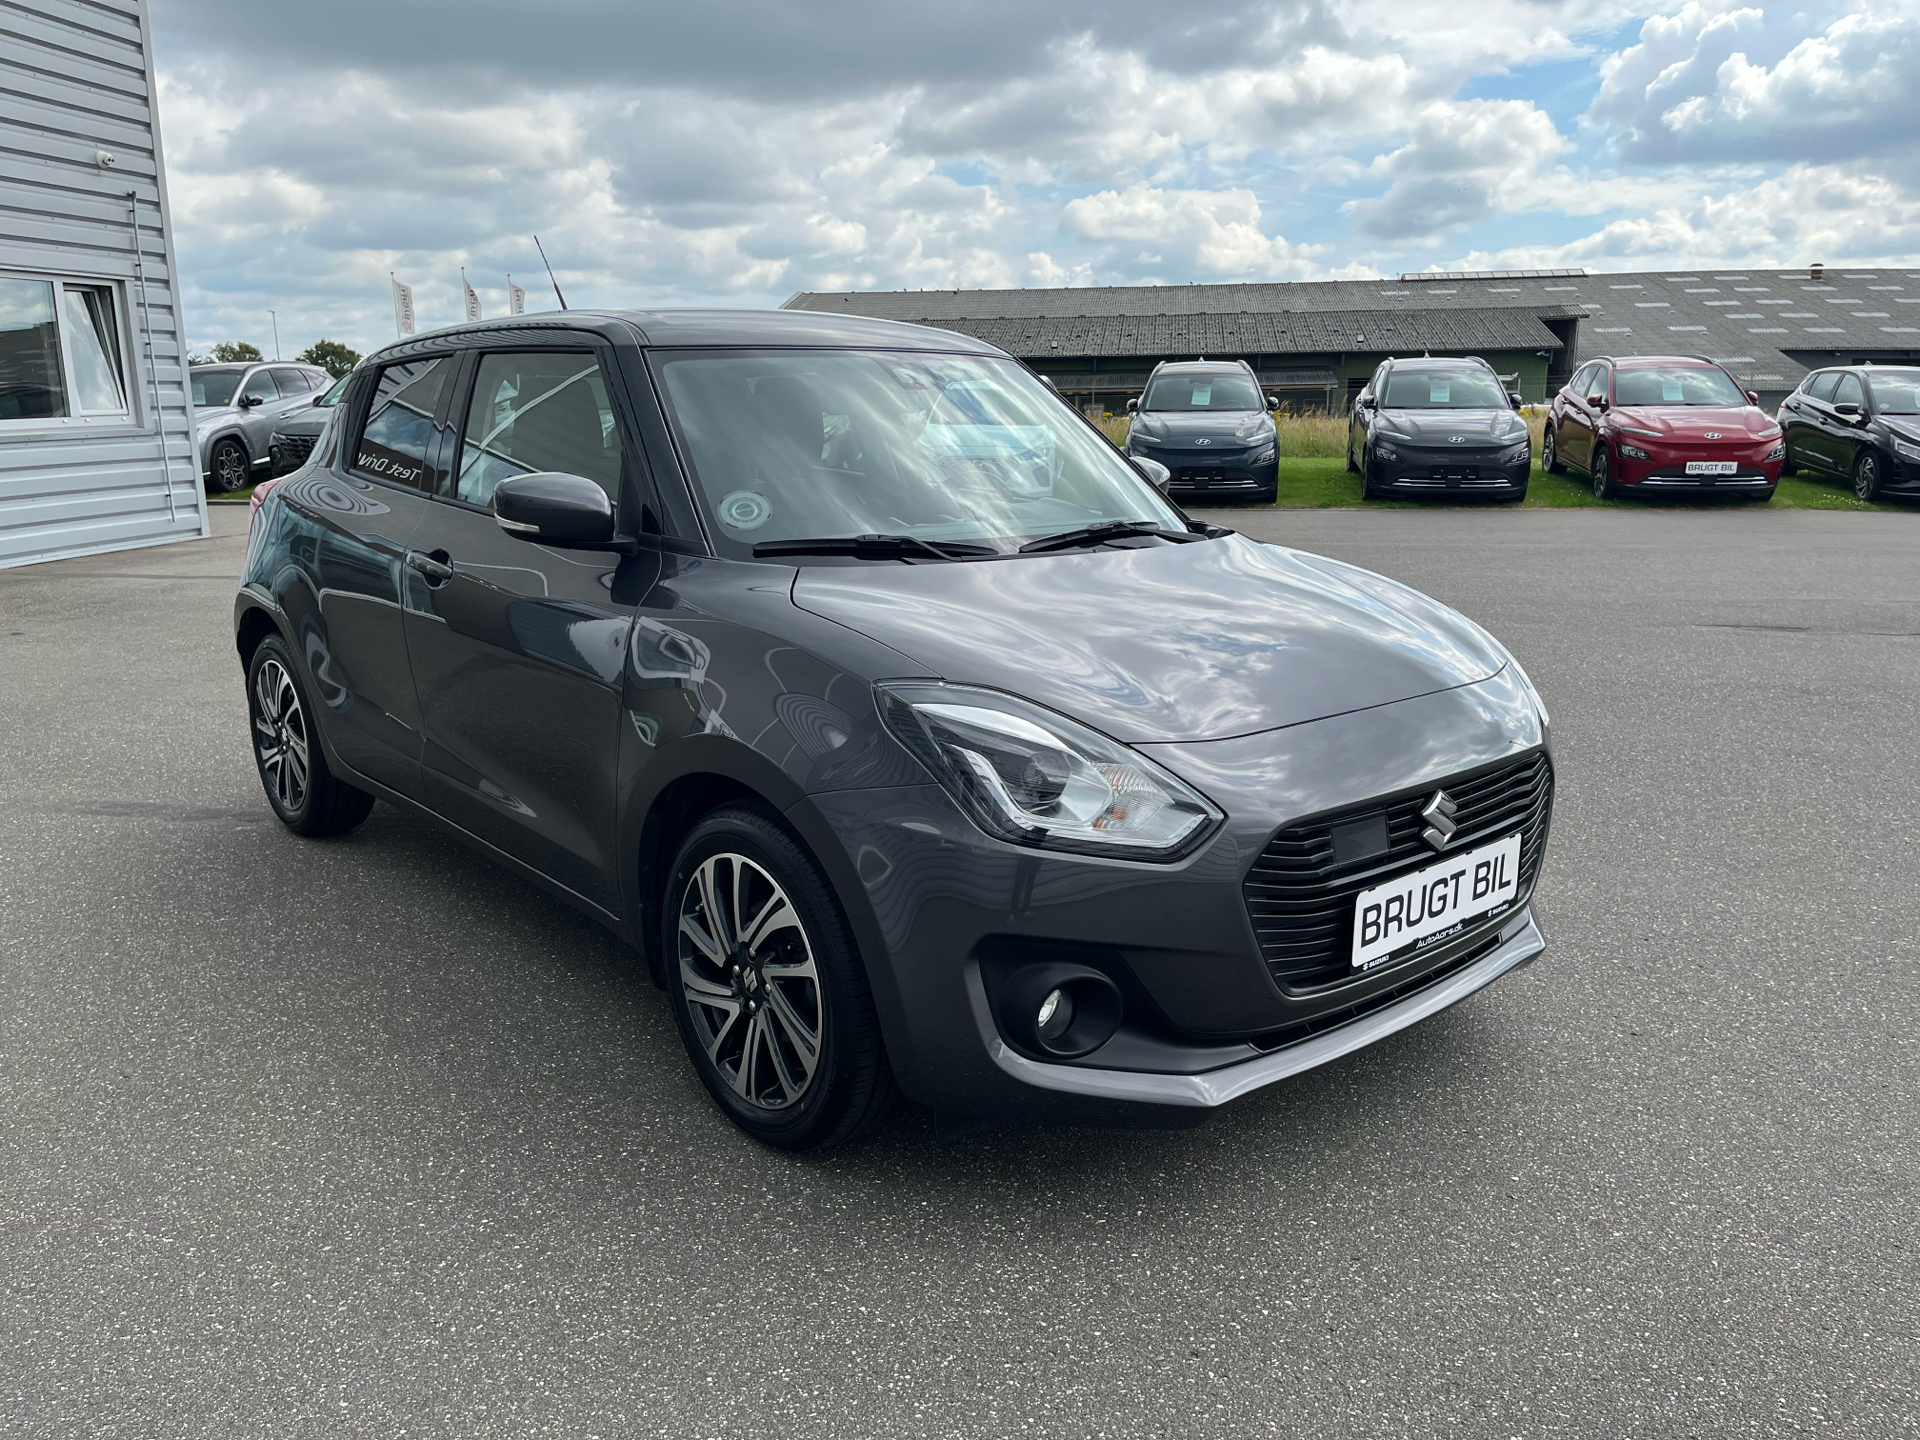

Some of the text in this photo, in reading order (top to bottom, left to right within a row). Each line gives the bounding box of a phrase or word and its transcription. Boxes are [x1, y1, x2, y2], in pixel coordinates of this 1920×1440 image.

[1361, 853, 1512, 948] BRUGT BIL
[1416, 922, 1464, 950] AutoAars.dk
[1369, 955, 1390, 968] SUZUKI
